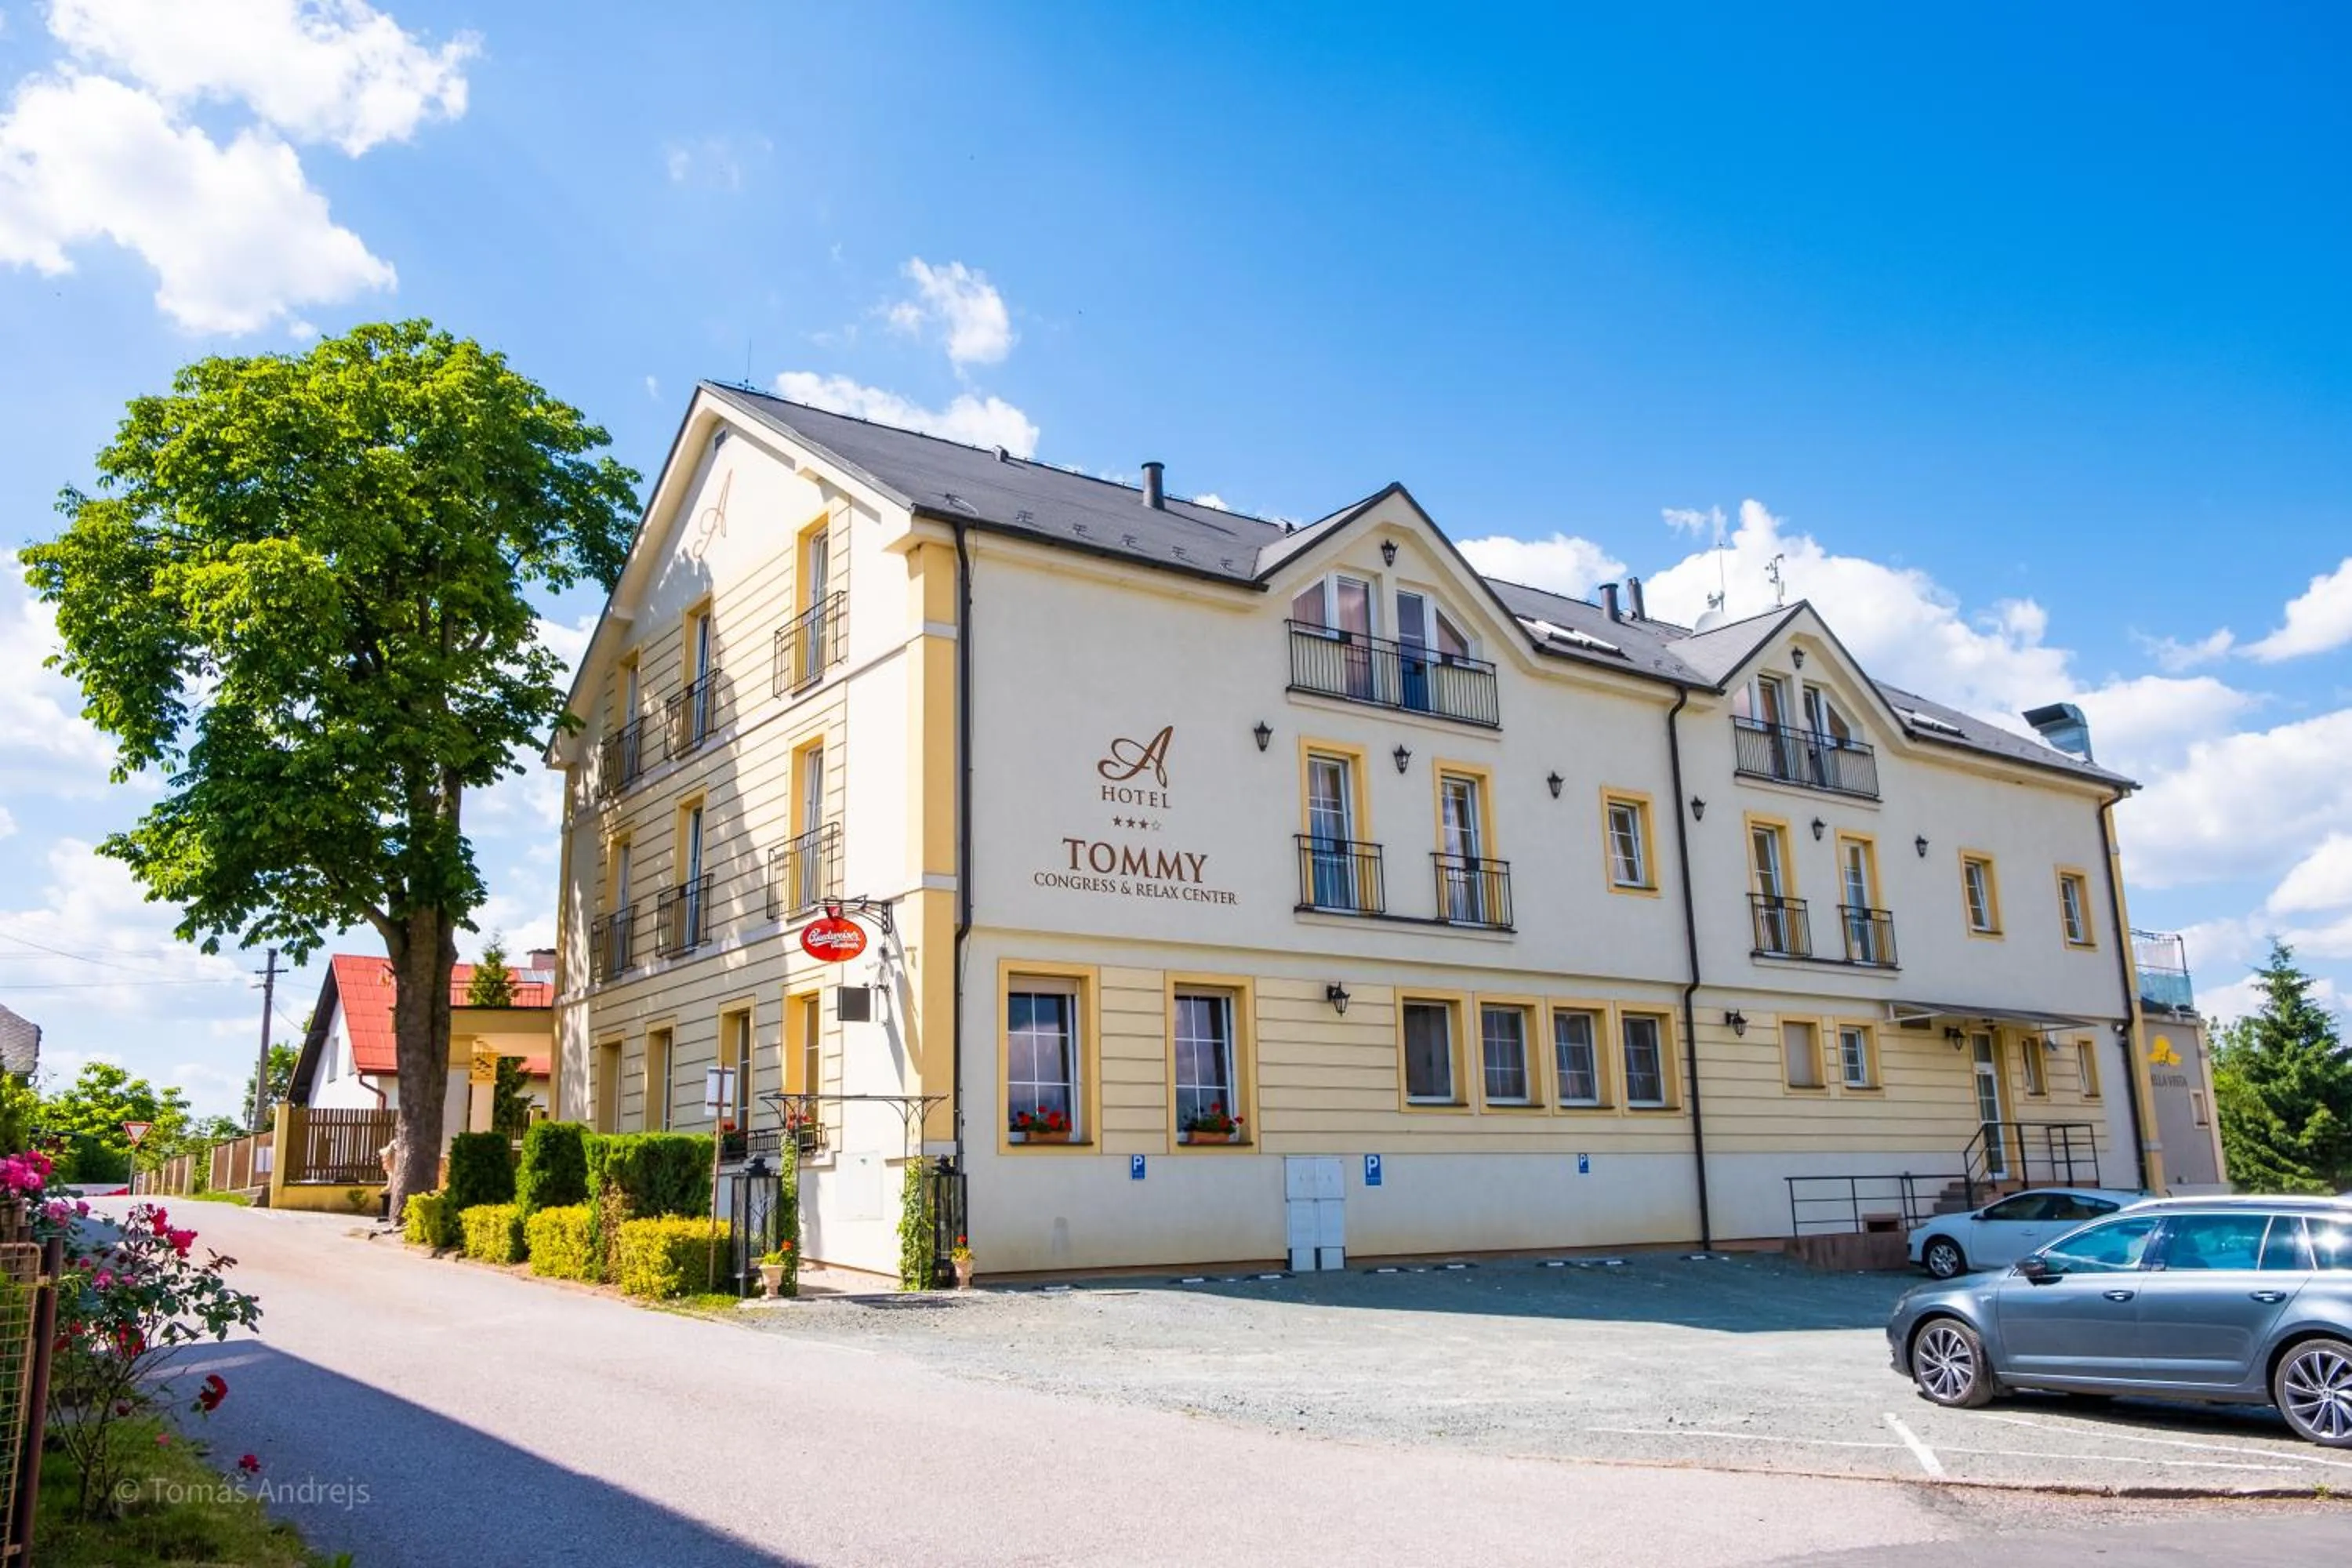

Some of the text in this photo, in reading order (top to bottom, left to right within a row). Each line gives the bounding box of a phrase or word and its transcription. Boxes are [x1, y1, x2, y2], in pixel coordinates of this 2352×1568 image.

[1101, 785, 1172, 809] HOTEL
[1062, 837, 1208, 884] TOMMY
[1033, 872, 1238, 905] CONGRESS & RELAX CENTER
[1134, 1155, 1143, 1171] P
[1367, 1156, 1378, 1176] P
[1580, 1153, 1586, 1167] P
